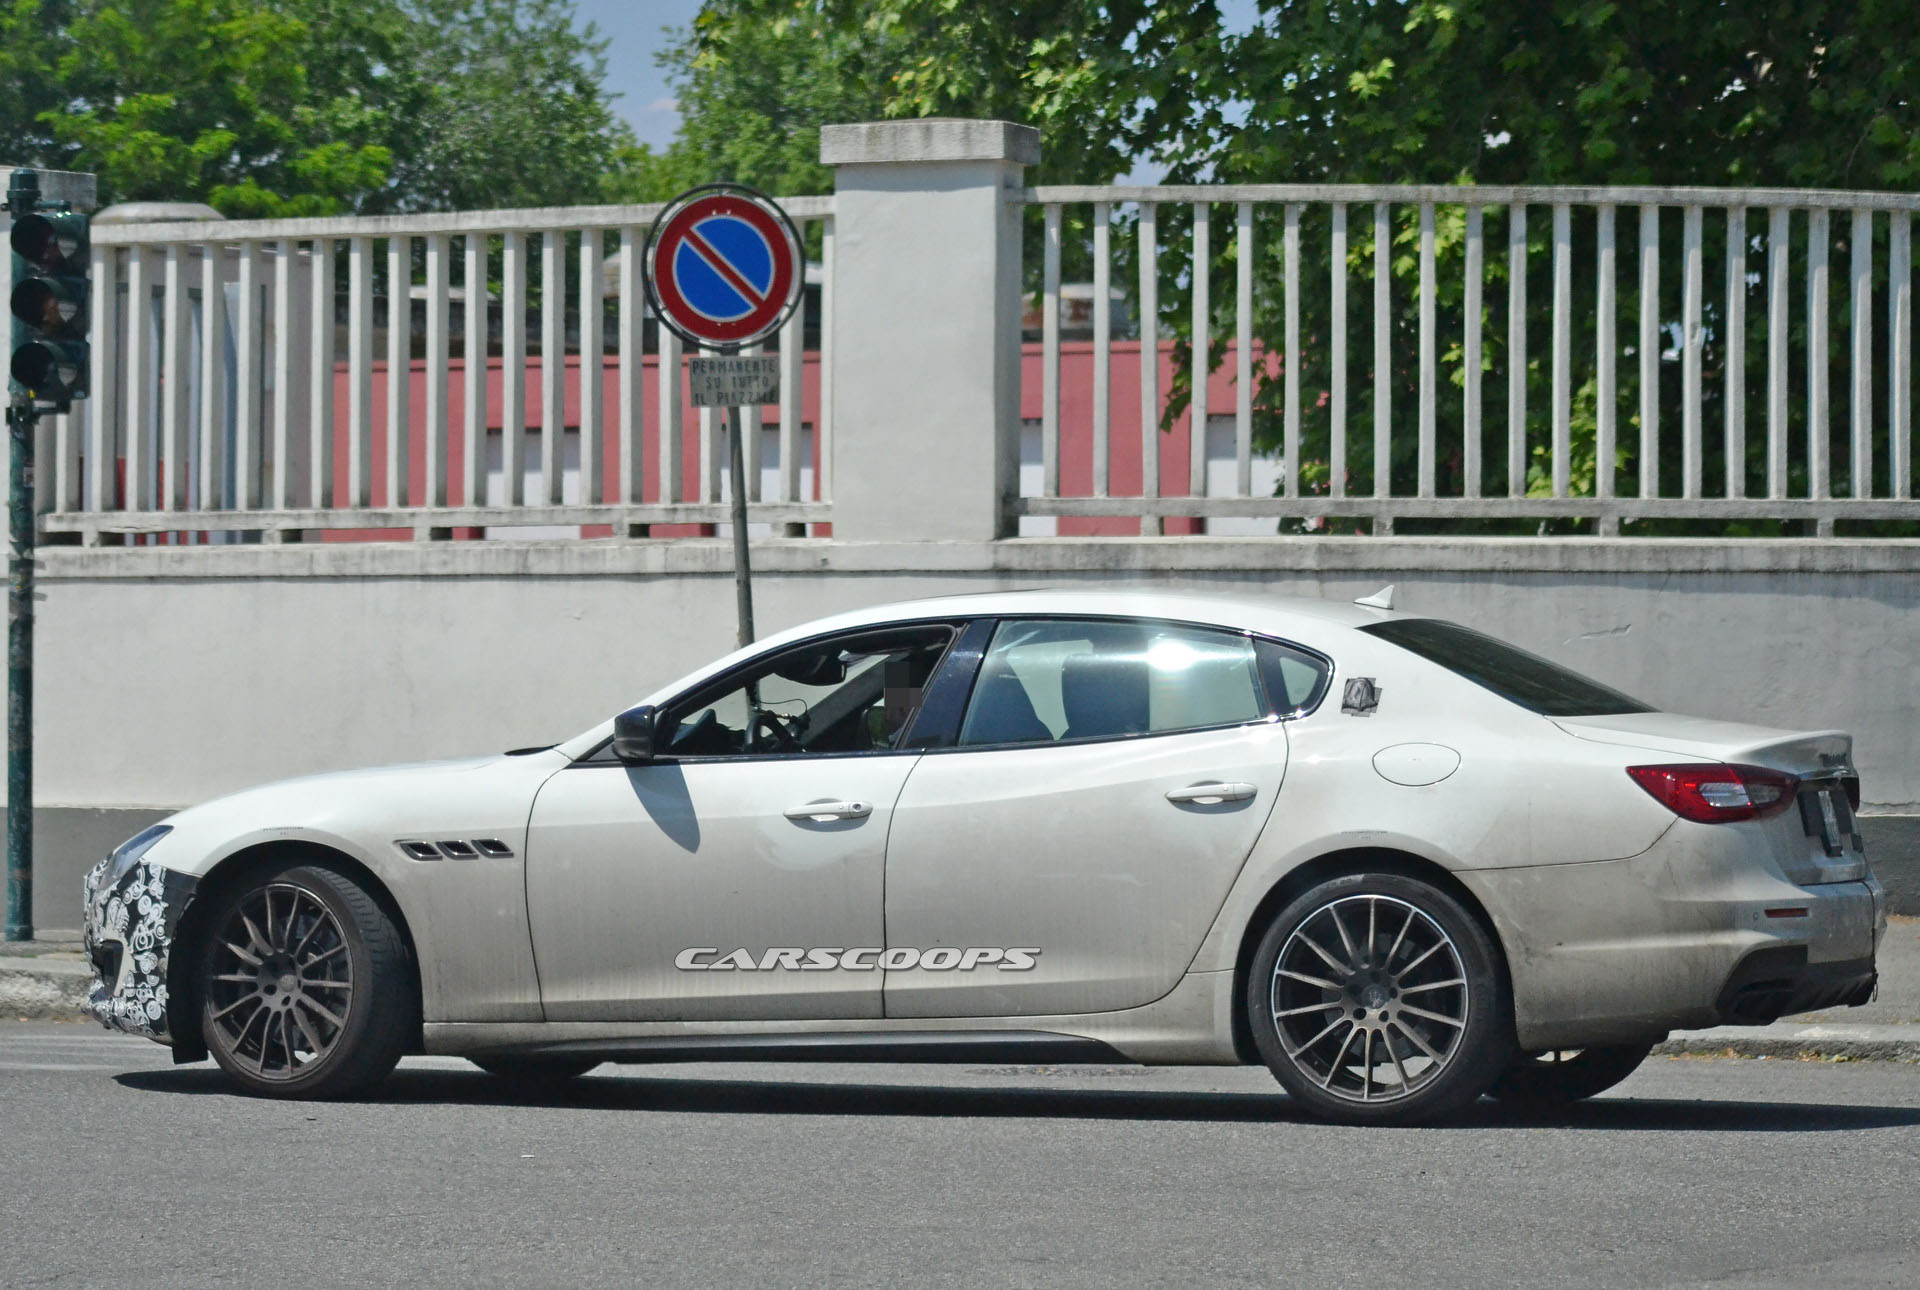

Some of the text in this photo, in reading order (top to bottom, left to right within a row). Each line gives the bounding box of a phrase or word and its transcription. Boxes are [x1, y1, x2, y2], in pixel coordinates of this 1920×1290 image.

[692, 360, 775, 374] PERMANENTE
[705, 375, 769, 389] SU TUTTO
